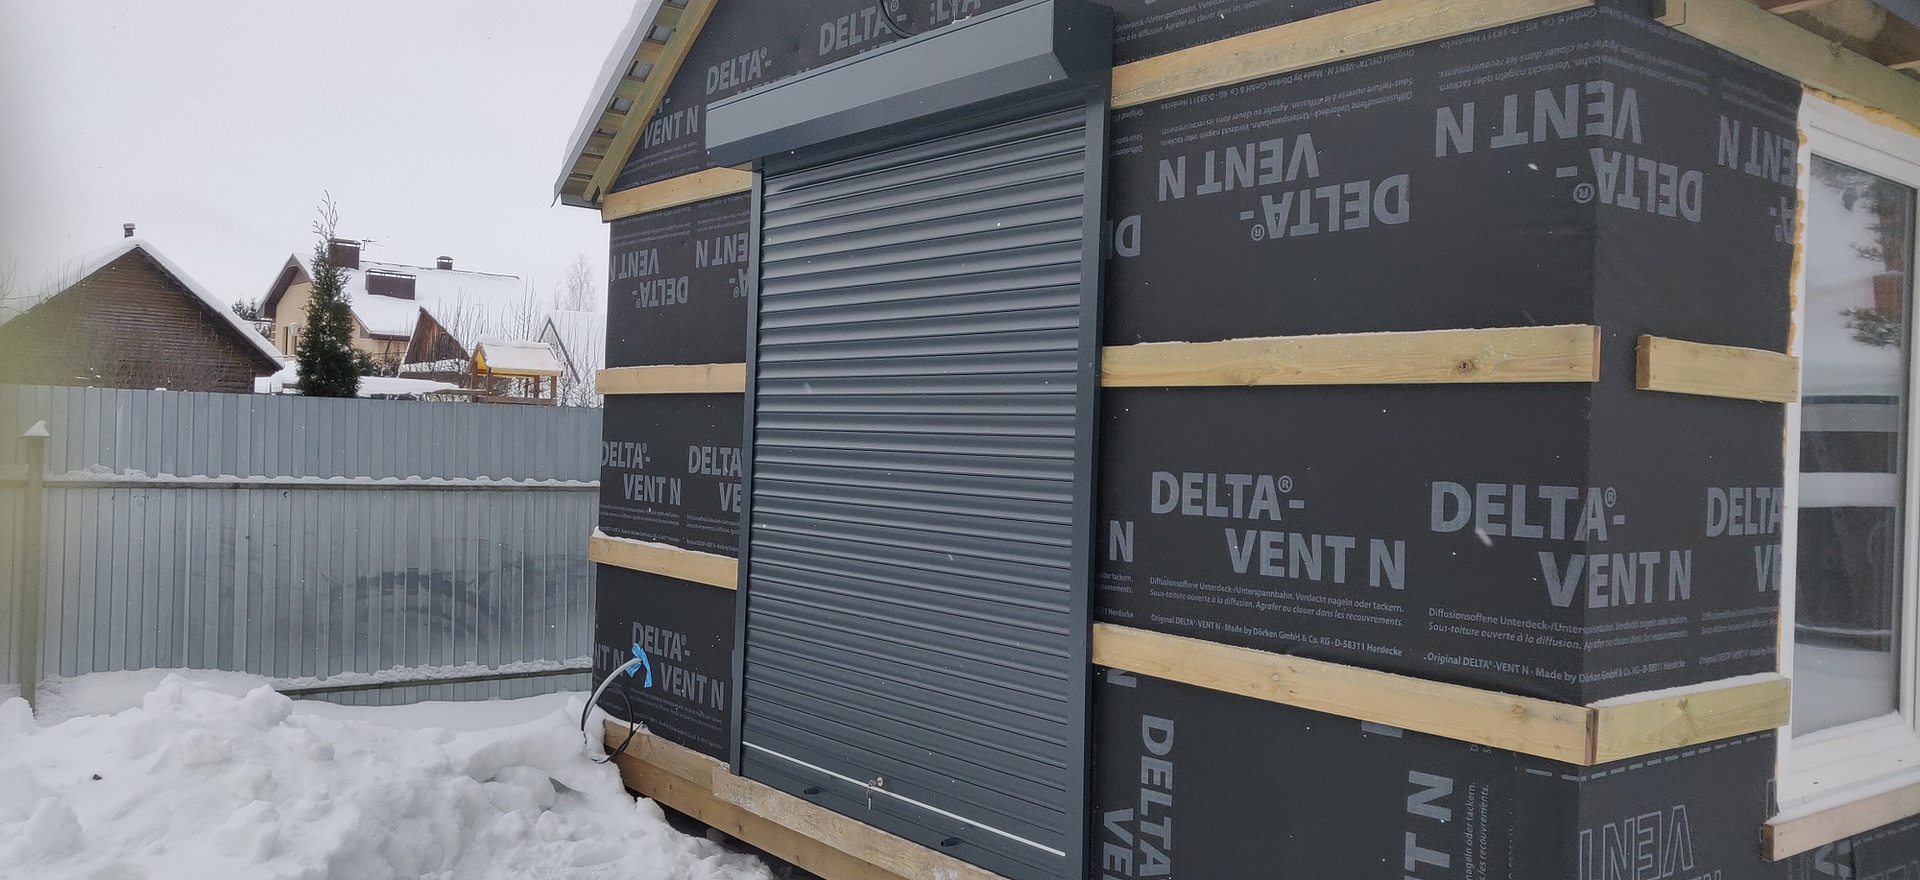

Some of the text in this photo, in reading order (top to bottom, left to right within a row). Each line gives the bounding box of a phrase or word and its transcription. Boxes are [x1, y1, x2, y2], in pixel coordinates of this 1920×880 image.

[1384, 48, 1415, 63] Original
[1293, 72, 1303, 82] by
[1303, 68, 1323, 80] Made
[1219, 90, 1228, 99] KG
[644, 109, 684, 149] VENT
[686, 105, 699, 135] N
[1435, 80, 1642, 157] VENT N
[1159, 133, 1320, 202] VENT N
[1718, 114, 1797, 188] ENT N
[619, 248, 659, 279] VENT
[695, 231, 749, 268] ENT N
[688, 445, 742, 477] DELTA
[623, 473, 682, 506] VENT N
[1109, 520, 1134, 563] N
[1225, 528, 1406, 590] VENT N
[1538, 549, 1692, 609] VENT N
[1187, 593, 1210, 604] ouverte
[1256, 601, 1281, 612] Agrafer
[1293, 605, 1314, 615] clouer
[1316, 608, 1333, 617] dans
[1334, 610, 1344, 619] les
[1296, 592, 1326, 604] Verdeckt
[1328, 597, 1352, 607] nageln
[1354, 599, 1372, 609] oder
[1428, 607, 1498, 625] Diffusionsoffene
[1151, 613, 1174, 625] Original
[1225, 623, 1242, 633] Made
[1243, 626, 1252, 636] by
[1320, 637, 1330, 646] KG
[1366, 643, 1402, 656] Herdecke
[1428, 621, 1480, 637] Sous-toiture
[1481, 628, 1515, 642] ouverte
[1525, 632, 1534, 643] la
[1536, 635, 1582, 650] diffusion.
[1427, 651, 1461, 666] Original
[1522, 665, 1529, 676] N
[1535, 667, 1562, 681] Made
[1564, 670, 1577, 685] by
[660, 662, 707, 704] VENT
[711, 679, 725, 711] N
[1139, 713, 1174, 878] DELTA
[1407, 770, 1453, 822] N
[1464, 822, 1474, 846] oder
